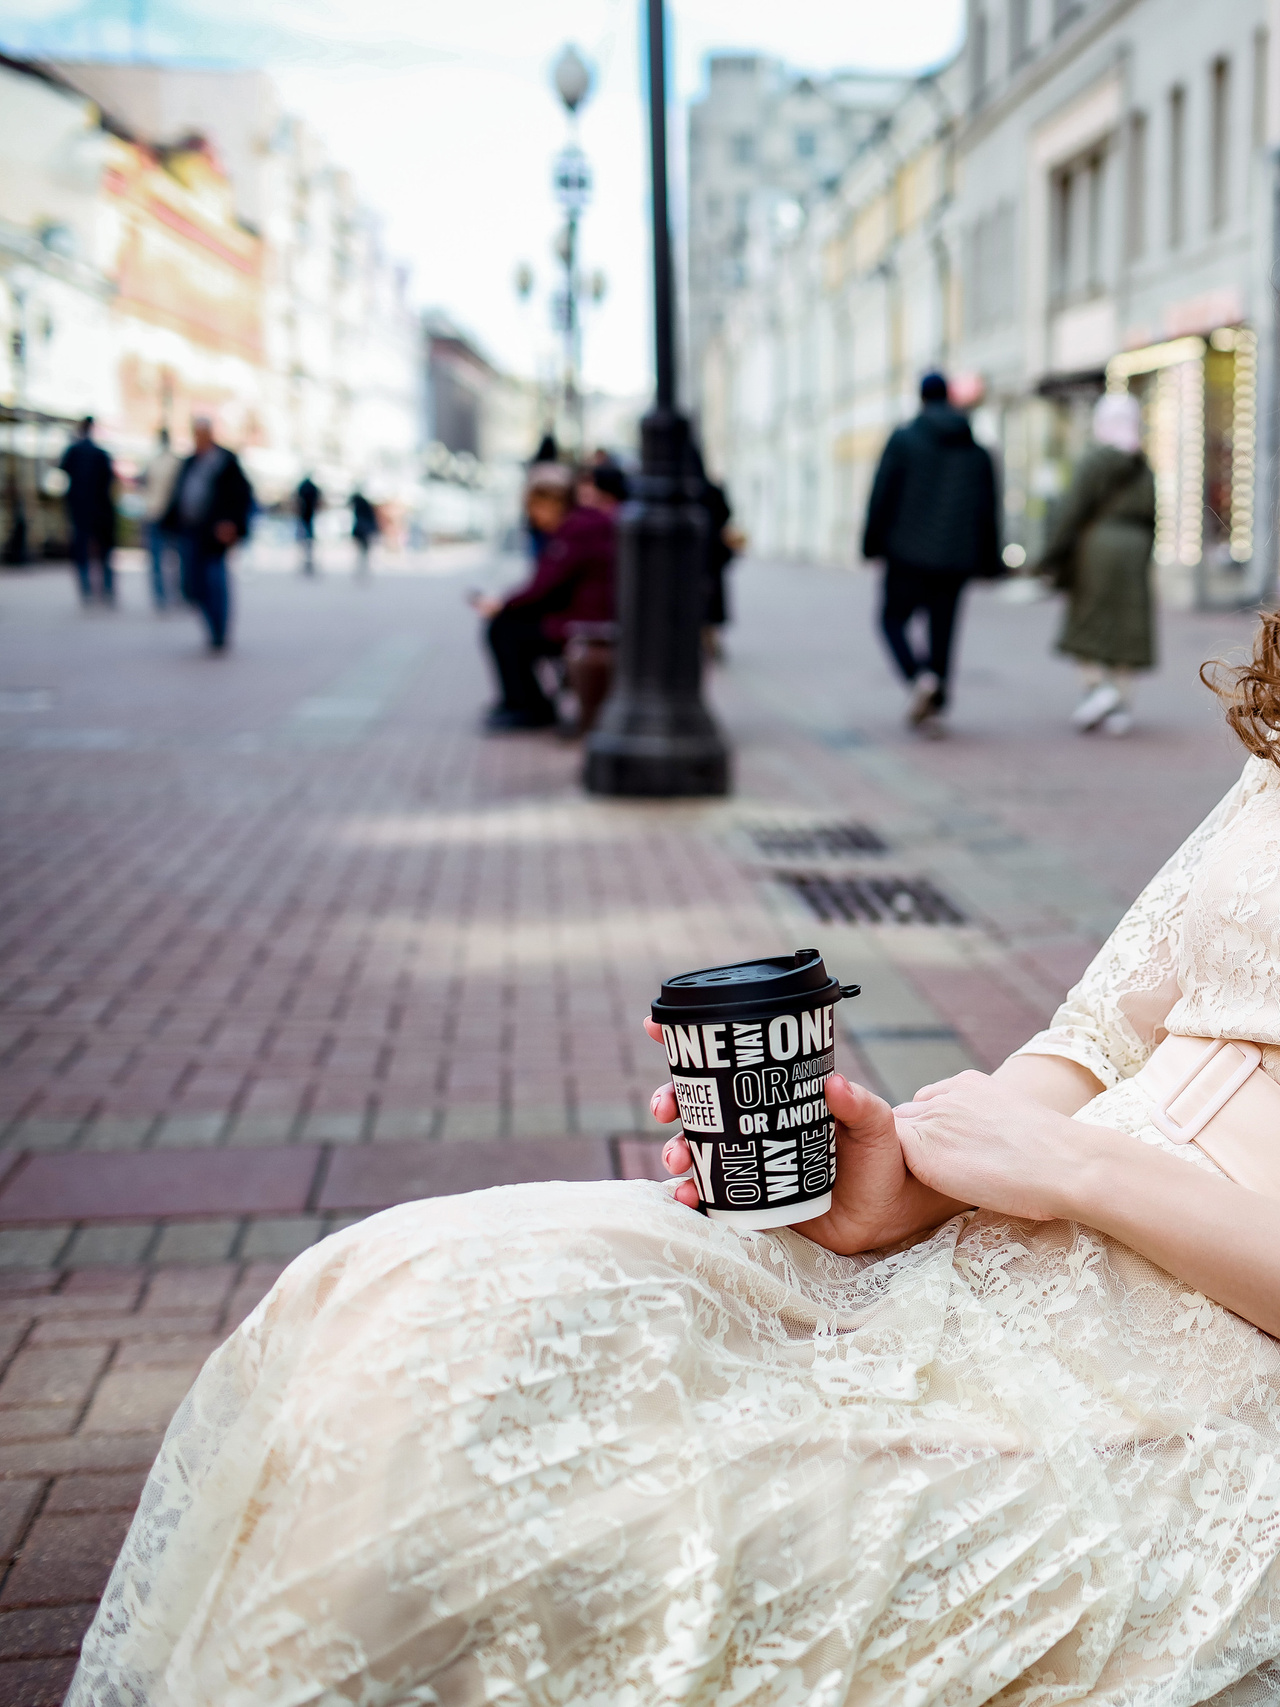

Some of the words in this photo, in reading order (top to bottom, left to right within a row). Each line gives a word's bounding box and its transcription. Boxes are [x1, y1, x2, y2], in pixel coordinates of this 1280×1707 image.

[662, 1024, 731, 1068] ONE
[732, 1023, 765, 1068] WAY
[768, 1004, 833, 1061] ONE
[680, 1083, 713, 1104] PRICE
[733, 1067, 790, 1109] OR
[681, 1104, 717, 1126] COFFEE
[739, 1113, 769, 1135] OR
[719, 1140, 761, 1205] ONE
[762, 1139, 799, 1202] WAY
[801, 1124, 828, 1193] ONE
